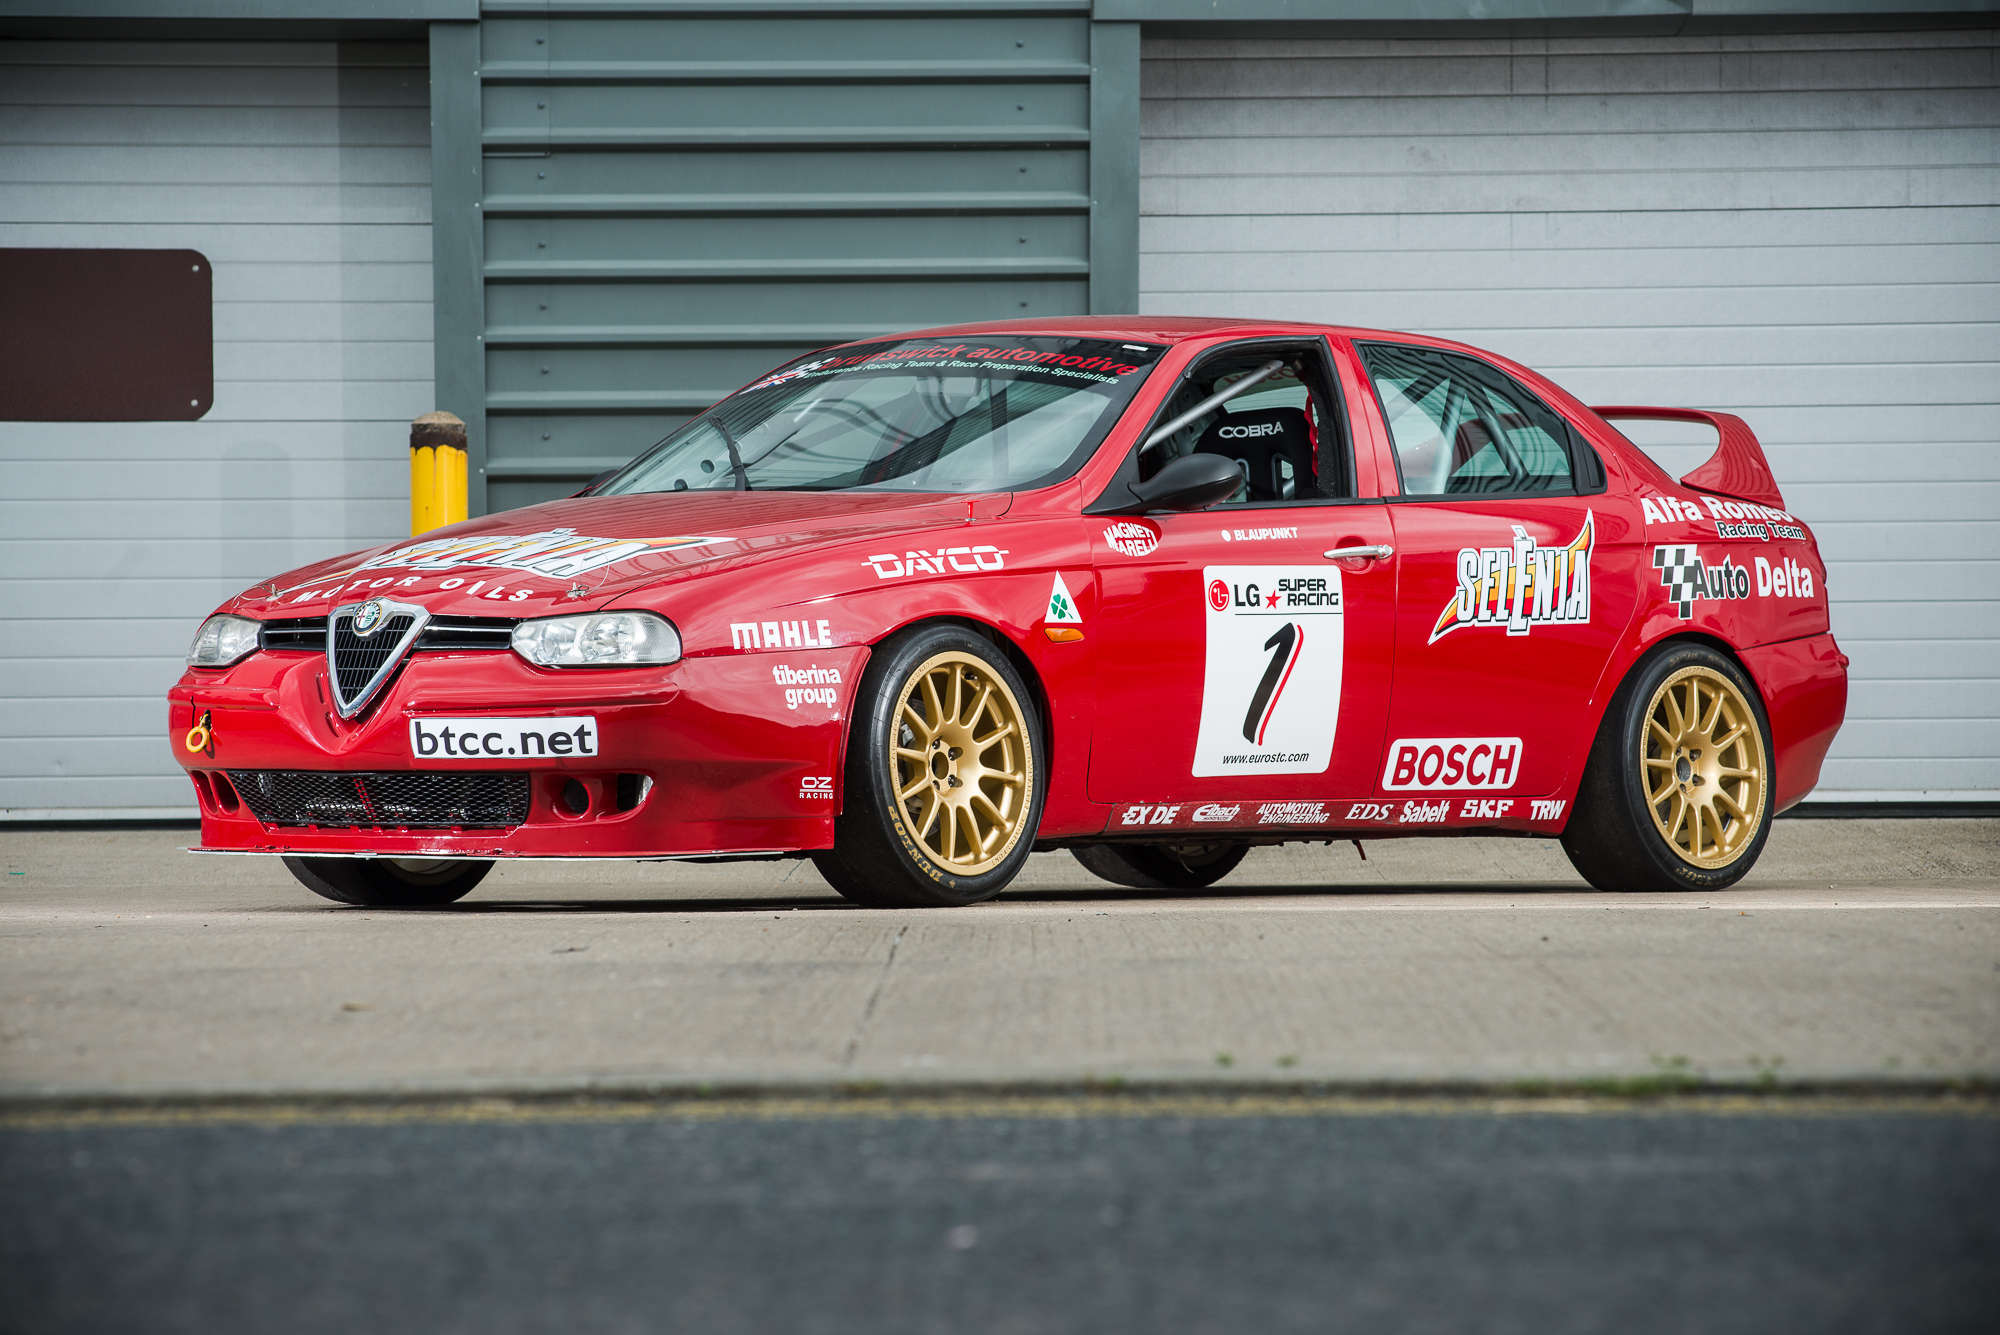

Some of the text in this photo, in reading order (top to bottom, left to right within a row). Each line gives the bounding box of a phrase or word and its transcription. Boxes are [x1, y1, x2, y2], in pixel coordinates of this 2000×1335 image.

[966, 345, 1139, 375] automotive
[904, 360, 936, 368] Team
[949, 360, 977, 368] Race
[979, 361, 1050, 374] Preparation
[1050, 367, 1120, 385] Specialists
[1218, 421, 1284, 439] COBRA
[1640, 496, 1704, 525] Alfa
[1234, 527, 1298, 541] BLAUPUNKT
[1717, 521, 1806, 541] Racing Team
[861, 545, 1009, 579] DAYCO
[1278, 579, 1326, 591] SUPER
[1691, 554, 1814, 600] Auto Delta
[290, 576, 533, 604] MOTOR OILS
[1233, 583, 1260, 607] LG
[1287, 593, 1339, 606] RACING
[730, 619, 832, 650] MAHLE
[772, 664, 842, 686] tiberina
[1243, 622, 1296, 744] 1
[785, 686, 837, 710] group
[415, 721, 593, 756] btcc.net
[1222, 752, 1309, 765] www.eurostc.com
[1391, 744, 1516, 786] BOSCH
[1256, 802, 1325, 814] AUTOMOTIVE
[1258, 813, 1330, 824] ENGINEERING
[1345, 804, 1394, 821] EDS
[1399, 800, 1450, 823] Sabelt
[1460, 800, 1513, 818] SKF
[1530, 800, 1566, 820] TRW
[888, 806, 944, 882] DUNLOP
